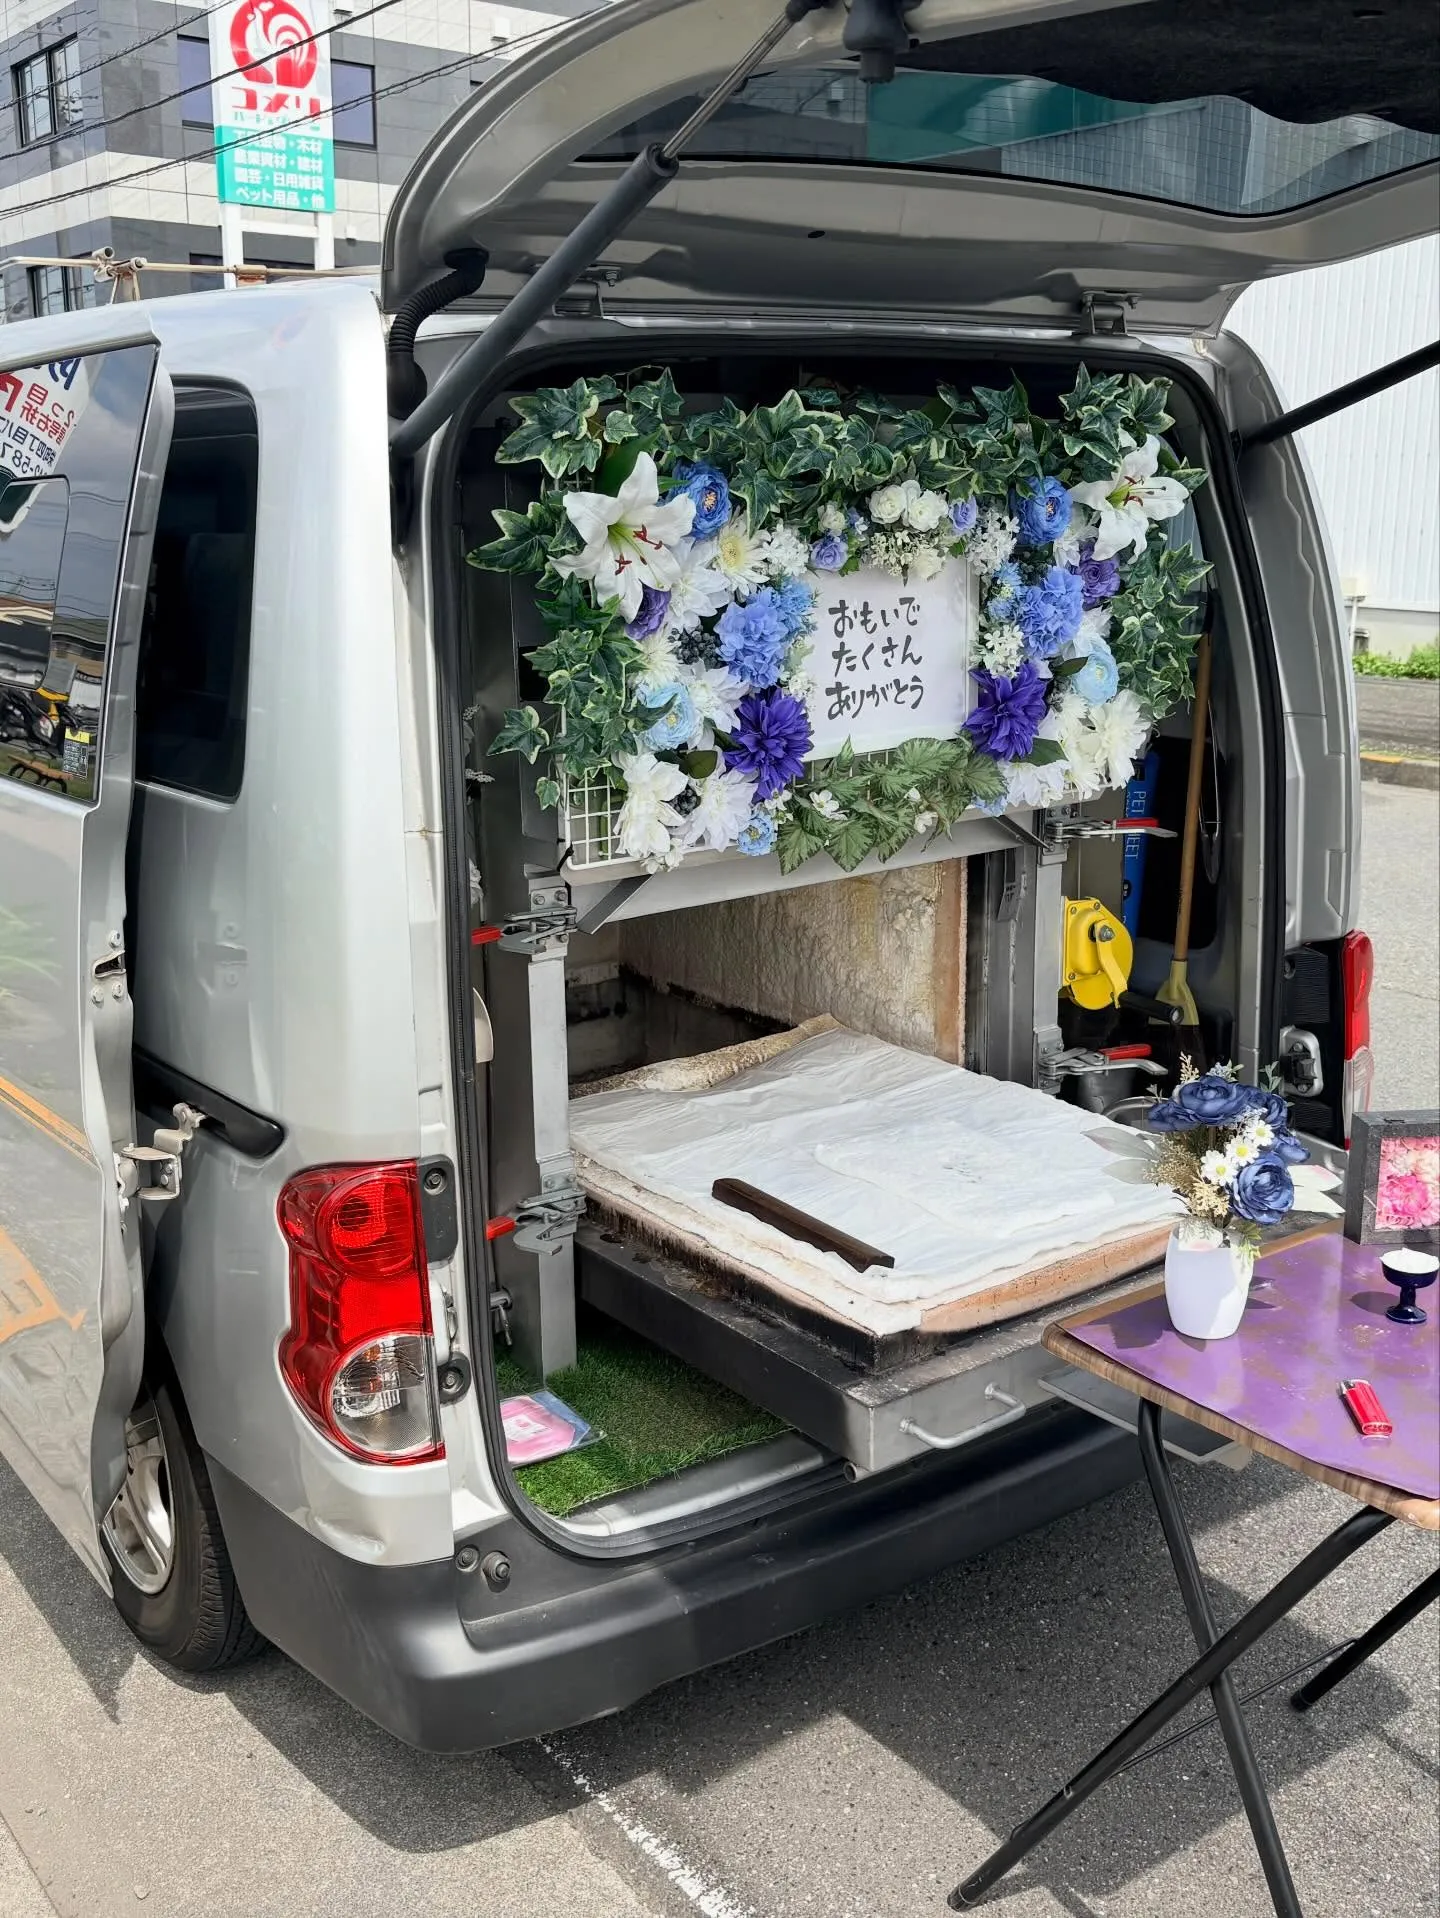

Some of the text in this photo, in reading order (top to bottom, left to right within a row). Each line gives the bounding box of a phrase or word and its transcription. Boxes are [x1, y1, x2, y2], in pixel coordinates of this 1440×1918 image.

[231, 86, 321, 119] コメリ
[828, 597, 920, 638] おもいで
[831, 635, 922, 677] たくさん
[825, 675, 924, 720] ありがとう
[1132, 791, 1146, 814] PET
